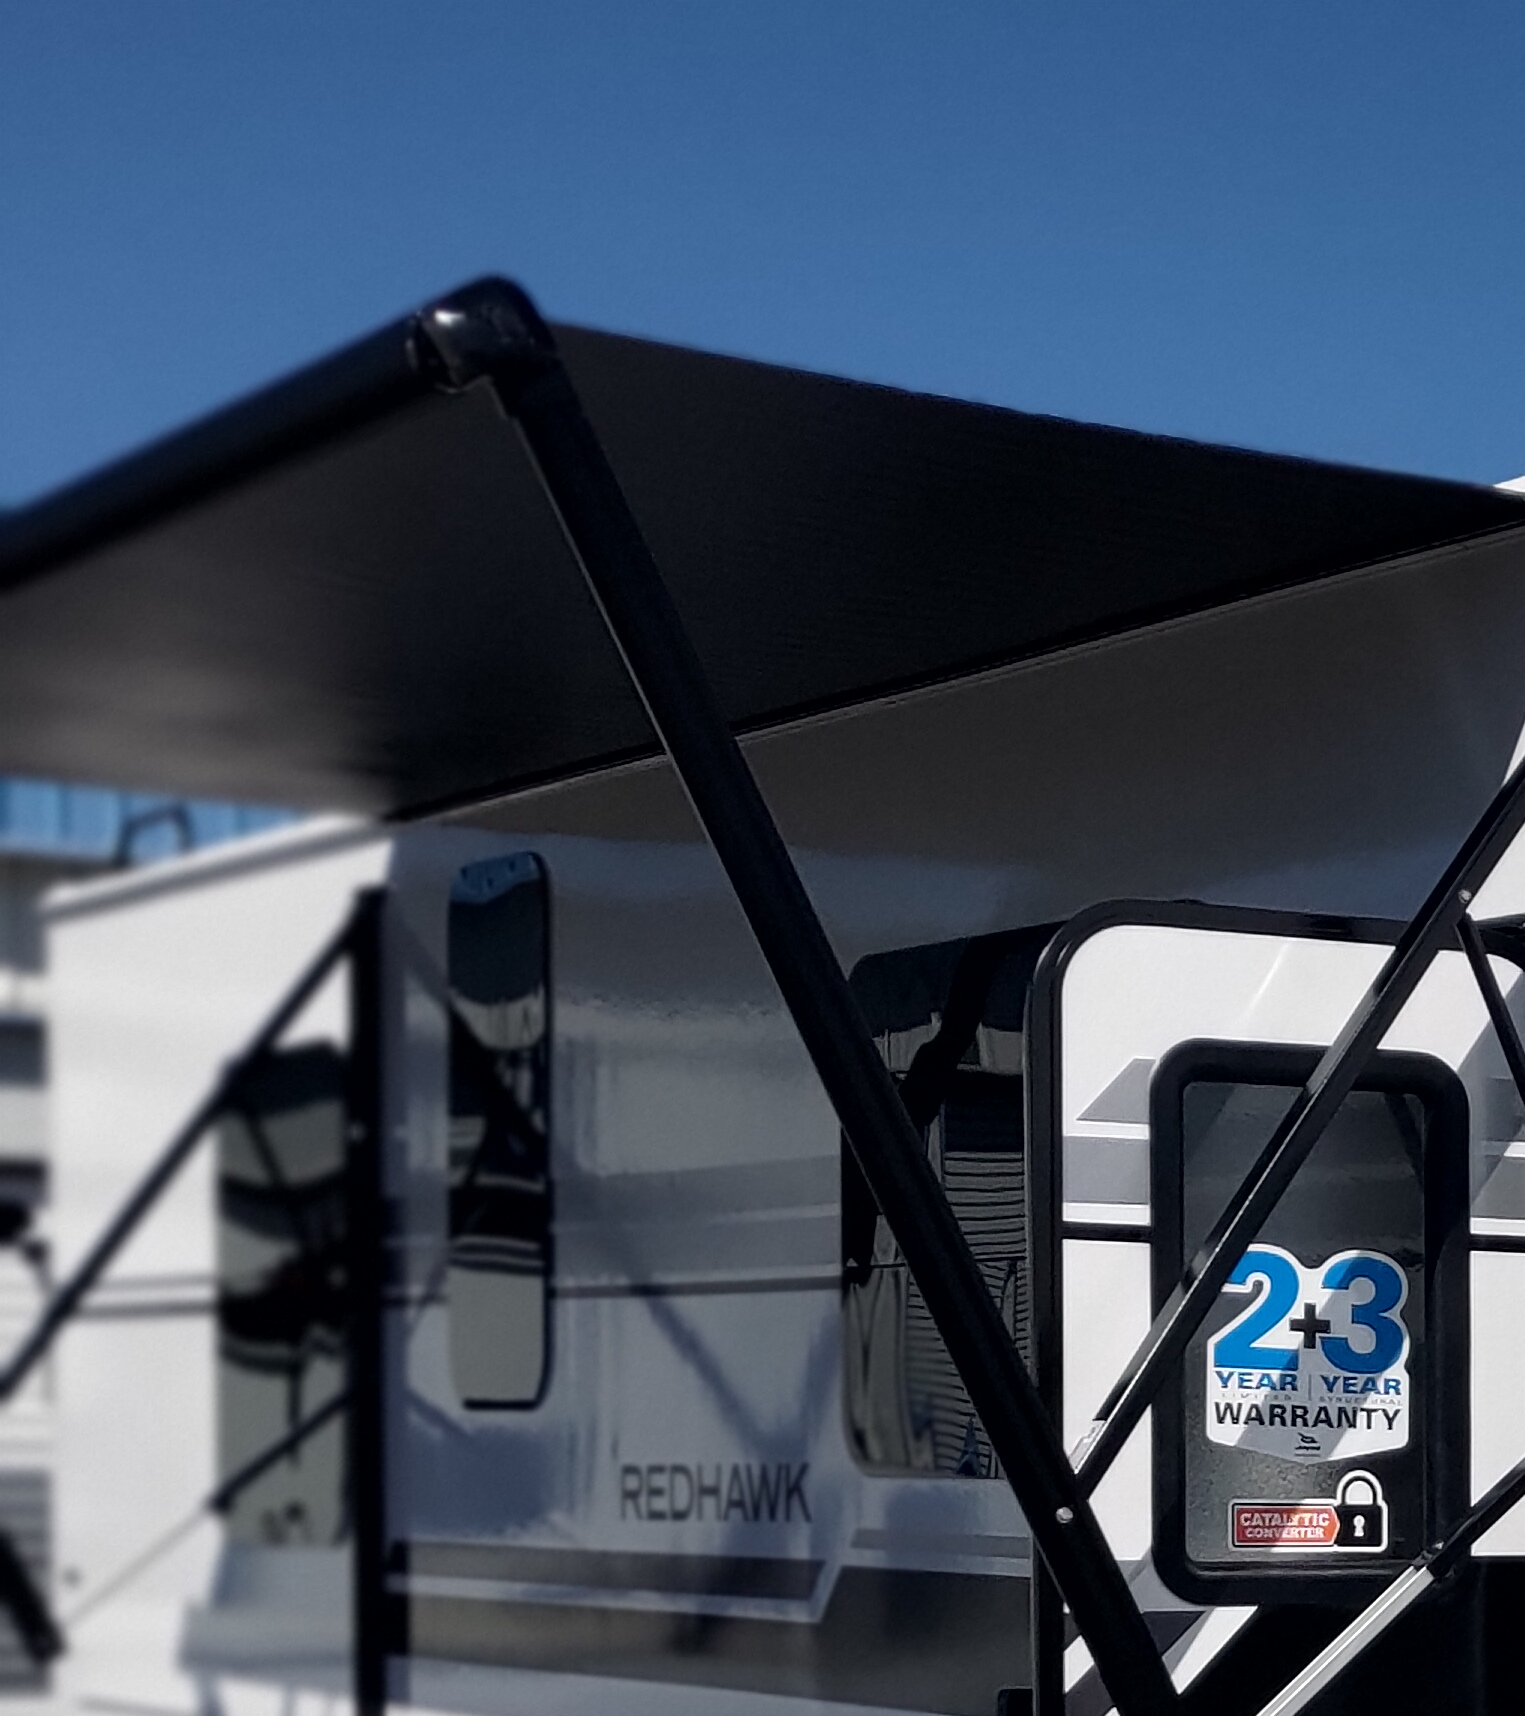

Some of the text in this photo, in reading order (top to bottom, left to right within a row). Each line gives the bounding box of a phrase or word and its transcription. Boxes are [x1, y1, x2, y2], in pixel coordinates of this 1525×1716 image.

[1214, 1370, 1402, 1396] YEAR YEAR
[1214, 1401, 1402, 1431] WARRANTY
[619, 1462, 813, 1523] REDHAWK
[1239, 1512, 1331, 1527] CATALYTIC
[1245, 1526, 1326, 1539] CONVERTER
